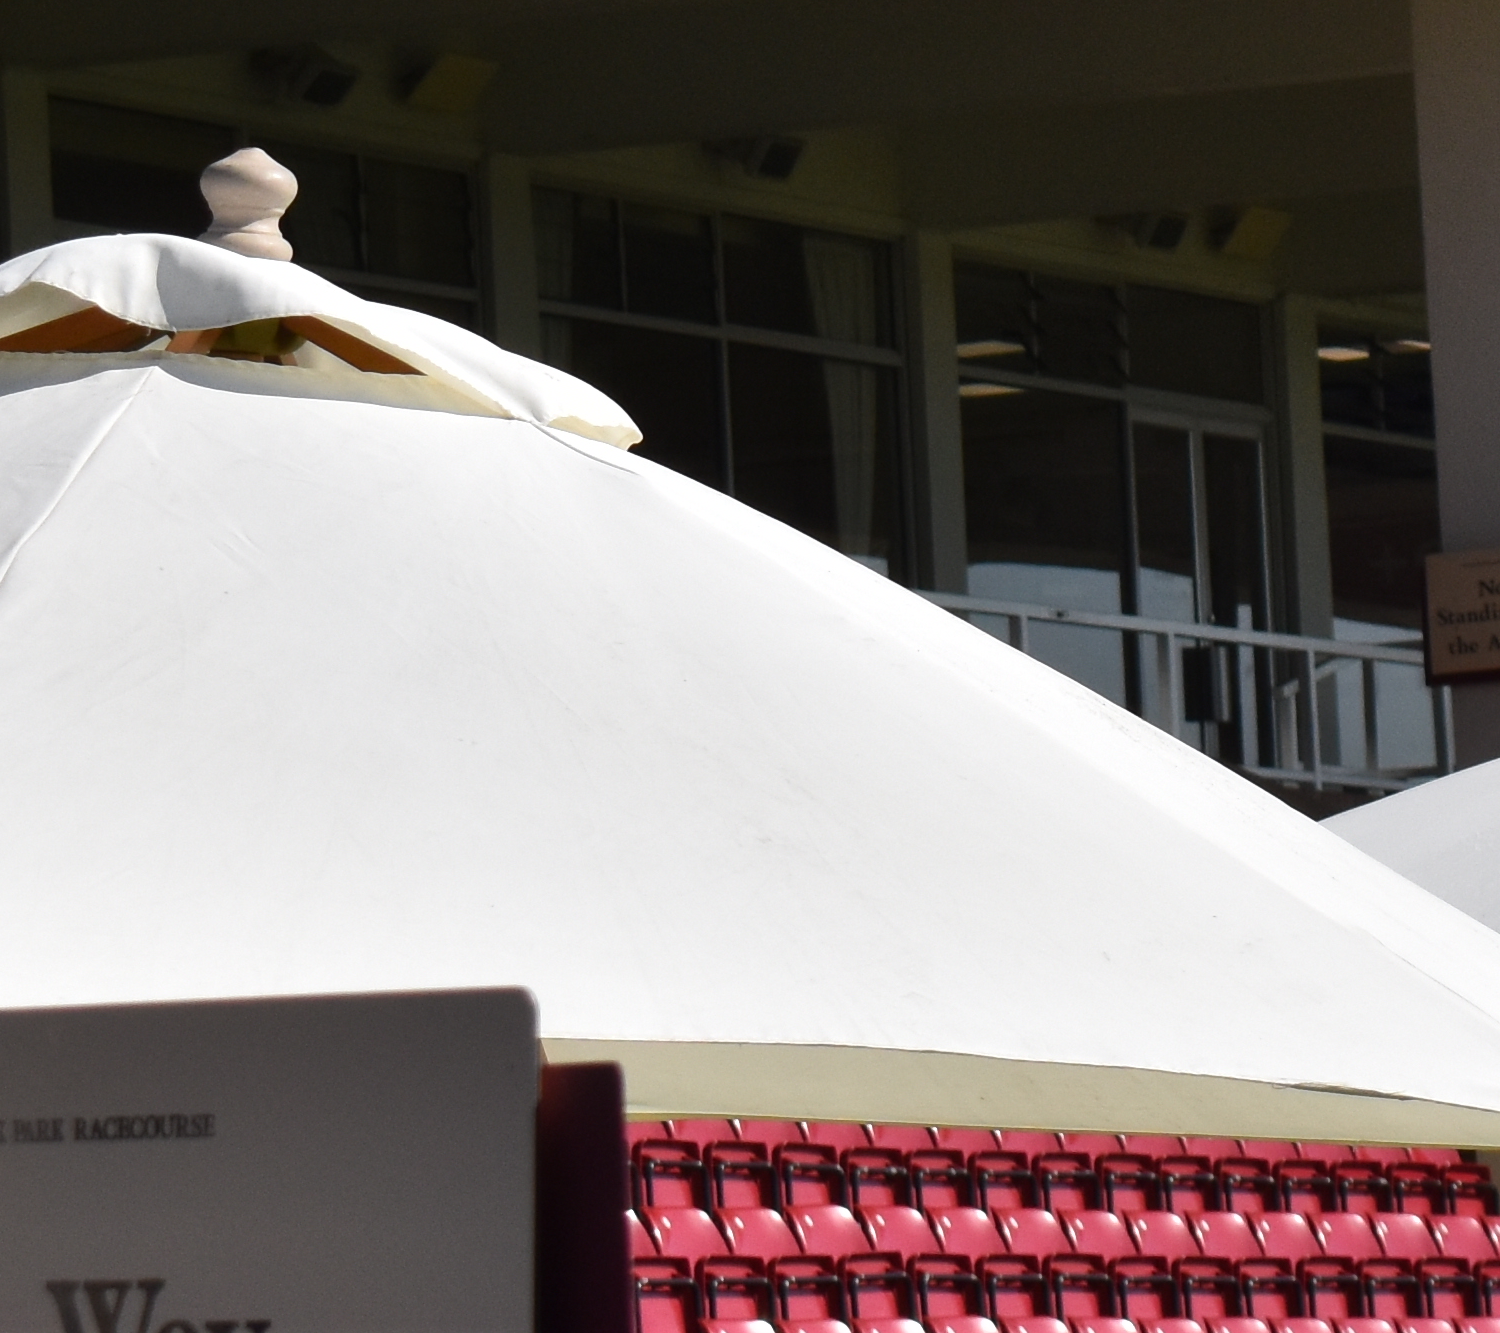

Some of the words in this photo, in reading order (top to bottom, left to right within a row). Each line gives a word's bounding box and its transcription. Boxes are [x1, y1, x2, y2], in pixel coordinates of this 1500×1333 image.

[1448, 636, 1479, 654] the
[13, 1117, 64, 1143] PARK
[74, 1113, 216, 1142] RACECOURSE
